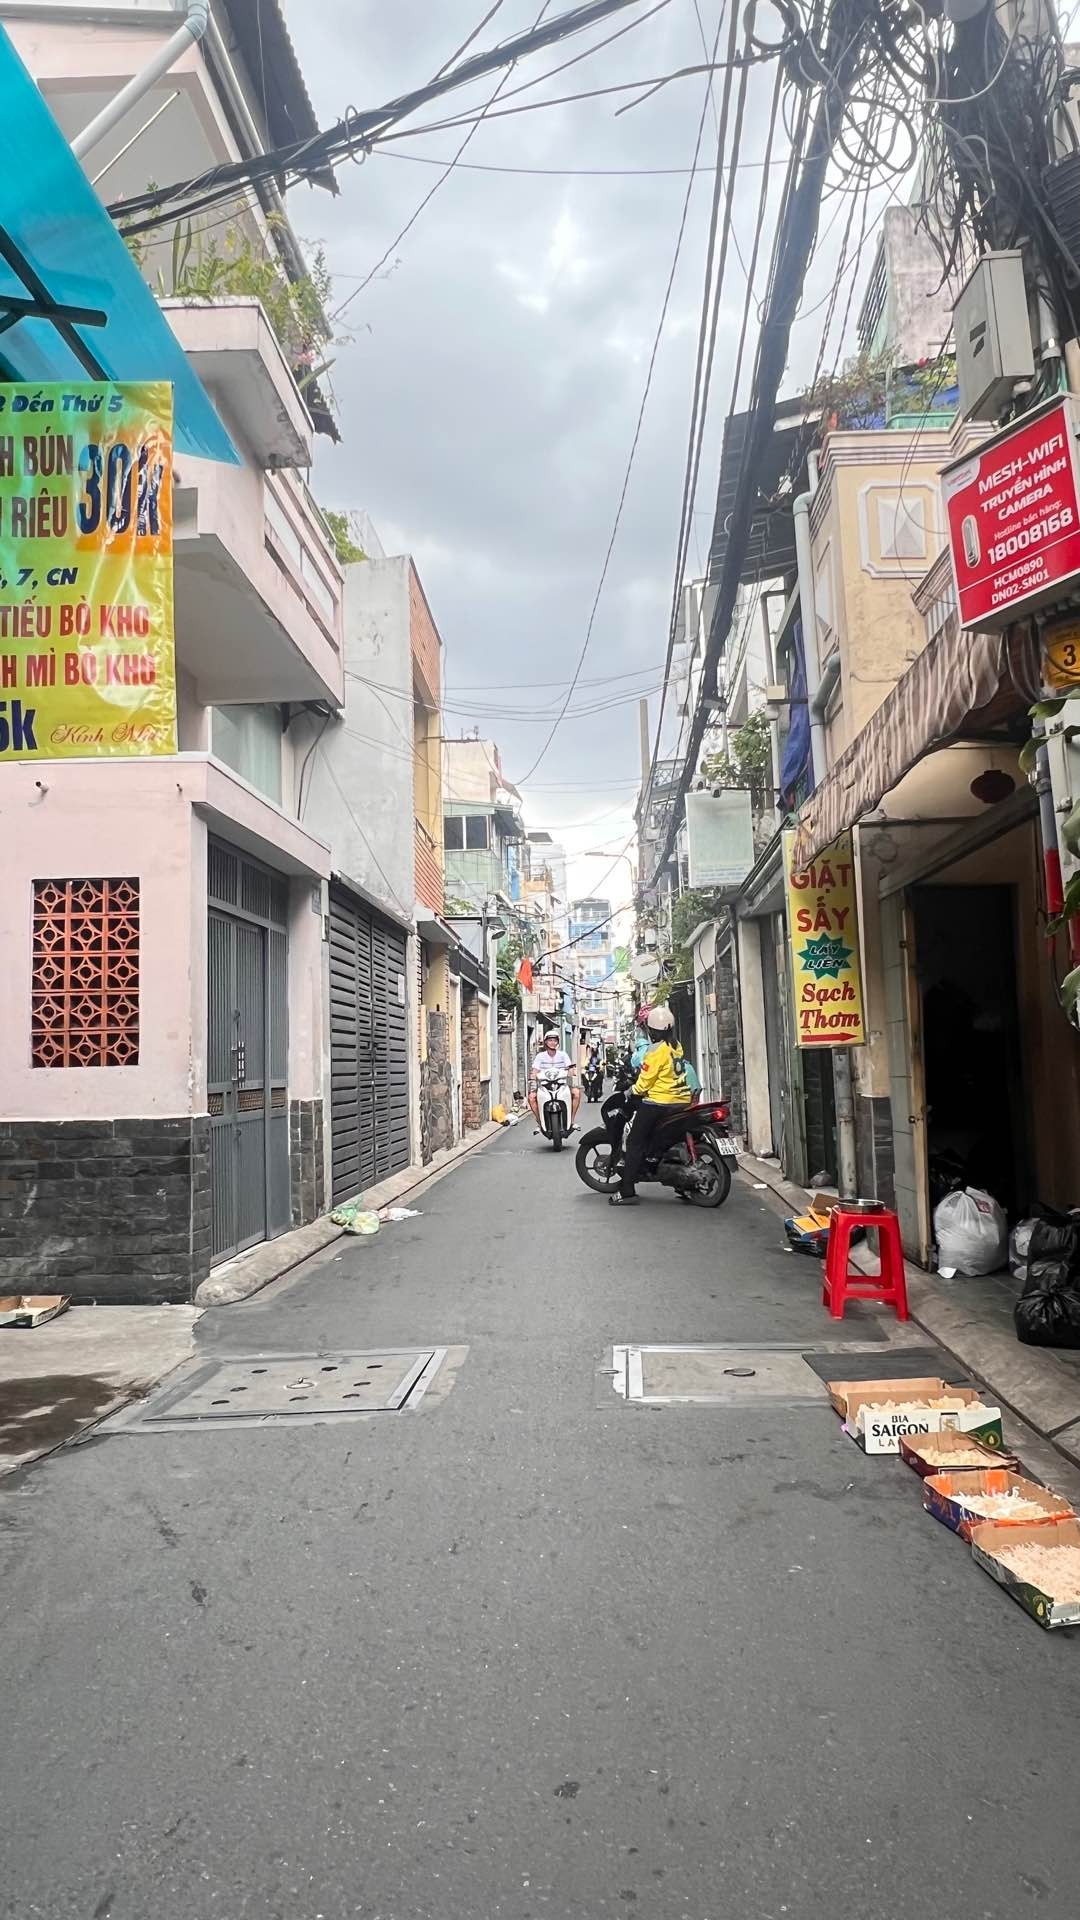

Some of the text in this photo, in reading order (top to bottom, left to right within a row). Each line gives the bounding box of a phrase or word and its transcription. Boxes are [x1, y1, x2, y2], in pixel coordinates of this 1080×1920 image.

[12, 391, 54, 412] Đến
[62, 393, 104, 412] Thứ
[108, 395, 124, 412] 5
[24, 426, 74, 477] BÚN
[979, 433, 1064, 495] MESH-WIFI
[981, 476, 1033, 513] TRUYỀN
[1033, 457, 1067, 484] HÌNH
[998, 483, 1053, 520] CAMERA
[12, 488, 67, 538] RIÊU
[987, 507, 1074, 565] 18008168
[47, 567, 78, 586] CN
[992, 569, 1050, 605] DN02-SN01
[994, 556, 1043, 589] HCM0890
[60, 595, 91, 636] BÒ
[100, 604, 149, 638] KHO
[26, 648, 56, 688] MÌ
[790, 860, 852, 894] GIẶT
[797, 896, 850, 932] SẤY
[801, 981, 856, 1006] Sạch
[800, 1009, 860, 1029] Thơm
[872, 1423, 929, 1438] SAIGON
[891, 1415, 909, 1423] BIA
